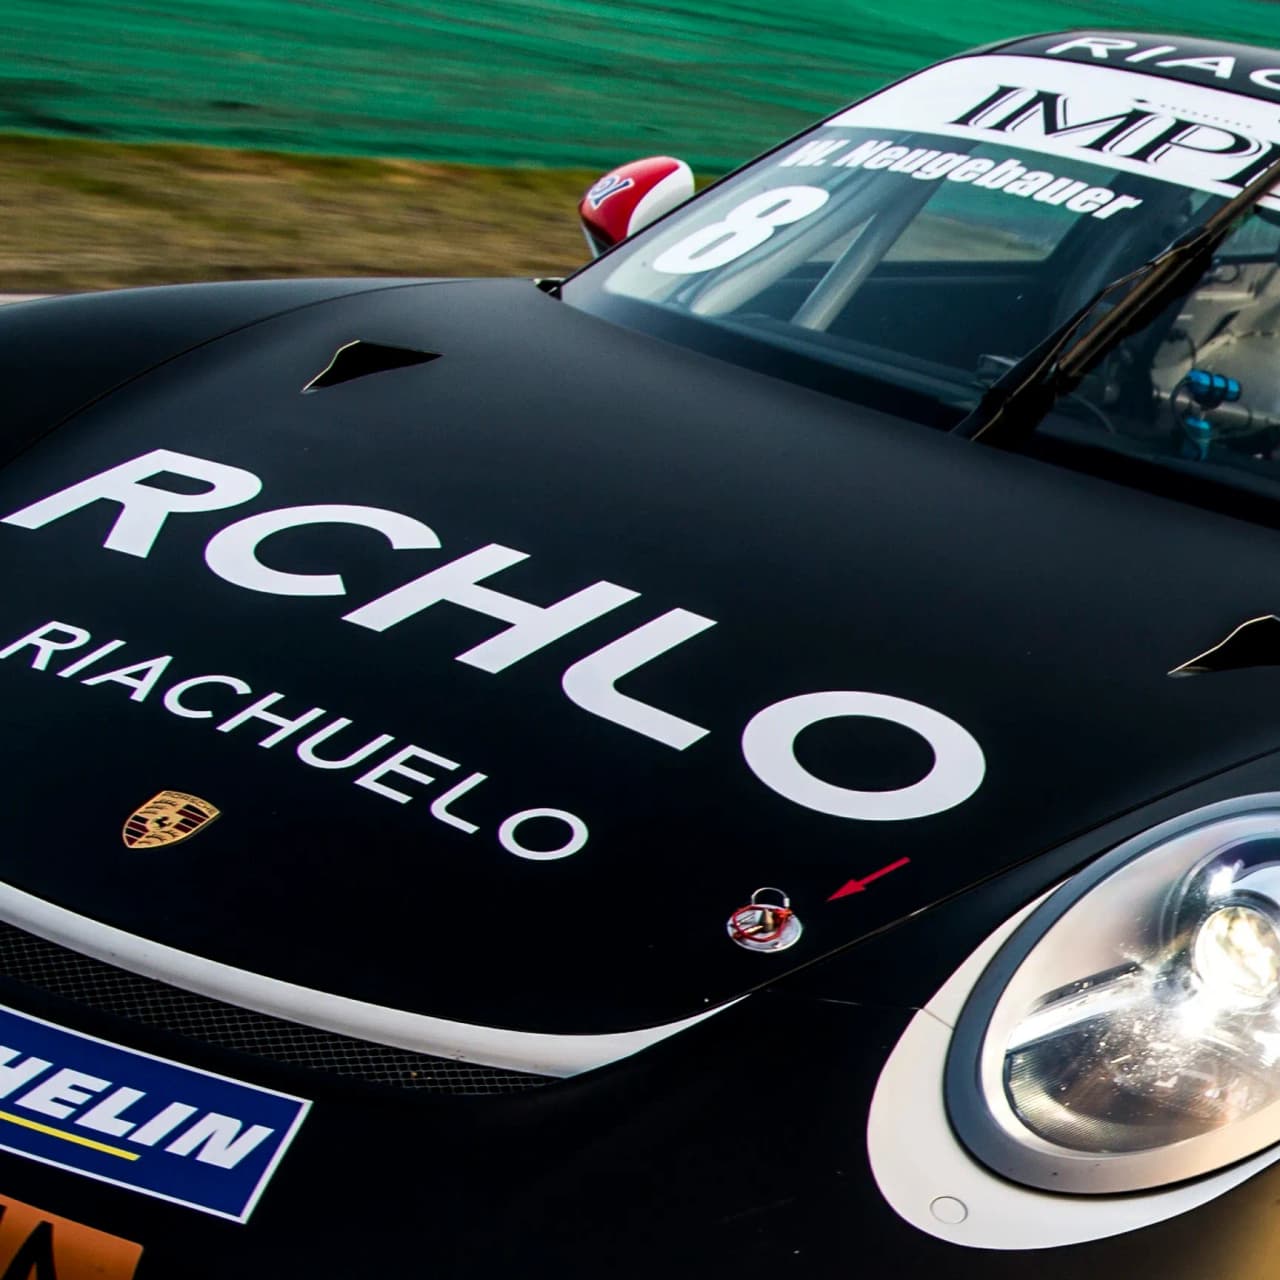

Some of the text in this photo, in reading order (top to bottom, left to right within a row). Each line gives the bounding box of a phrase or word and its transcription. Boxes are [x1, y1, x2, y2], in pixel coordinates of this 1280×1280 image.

[652, 184, 830, 275] 8
[779, 139, 1144, 220] W. Neugebauer
[0, 448, 987, 821] RCHLO
[0, 621, 589, 860] RIACHUELO
